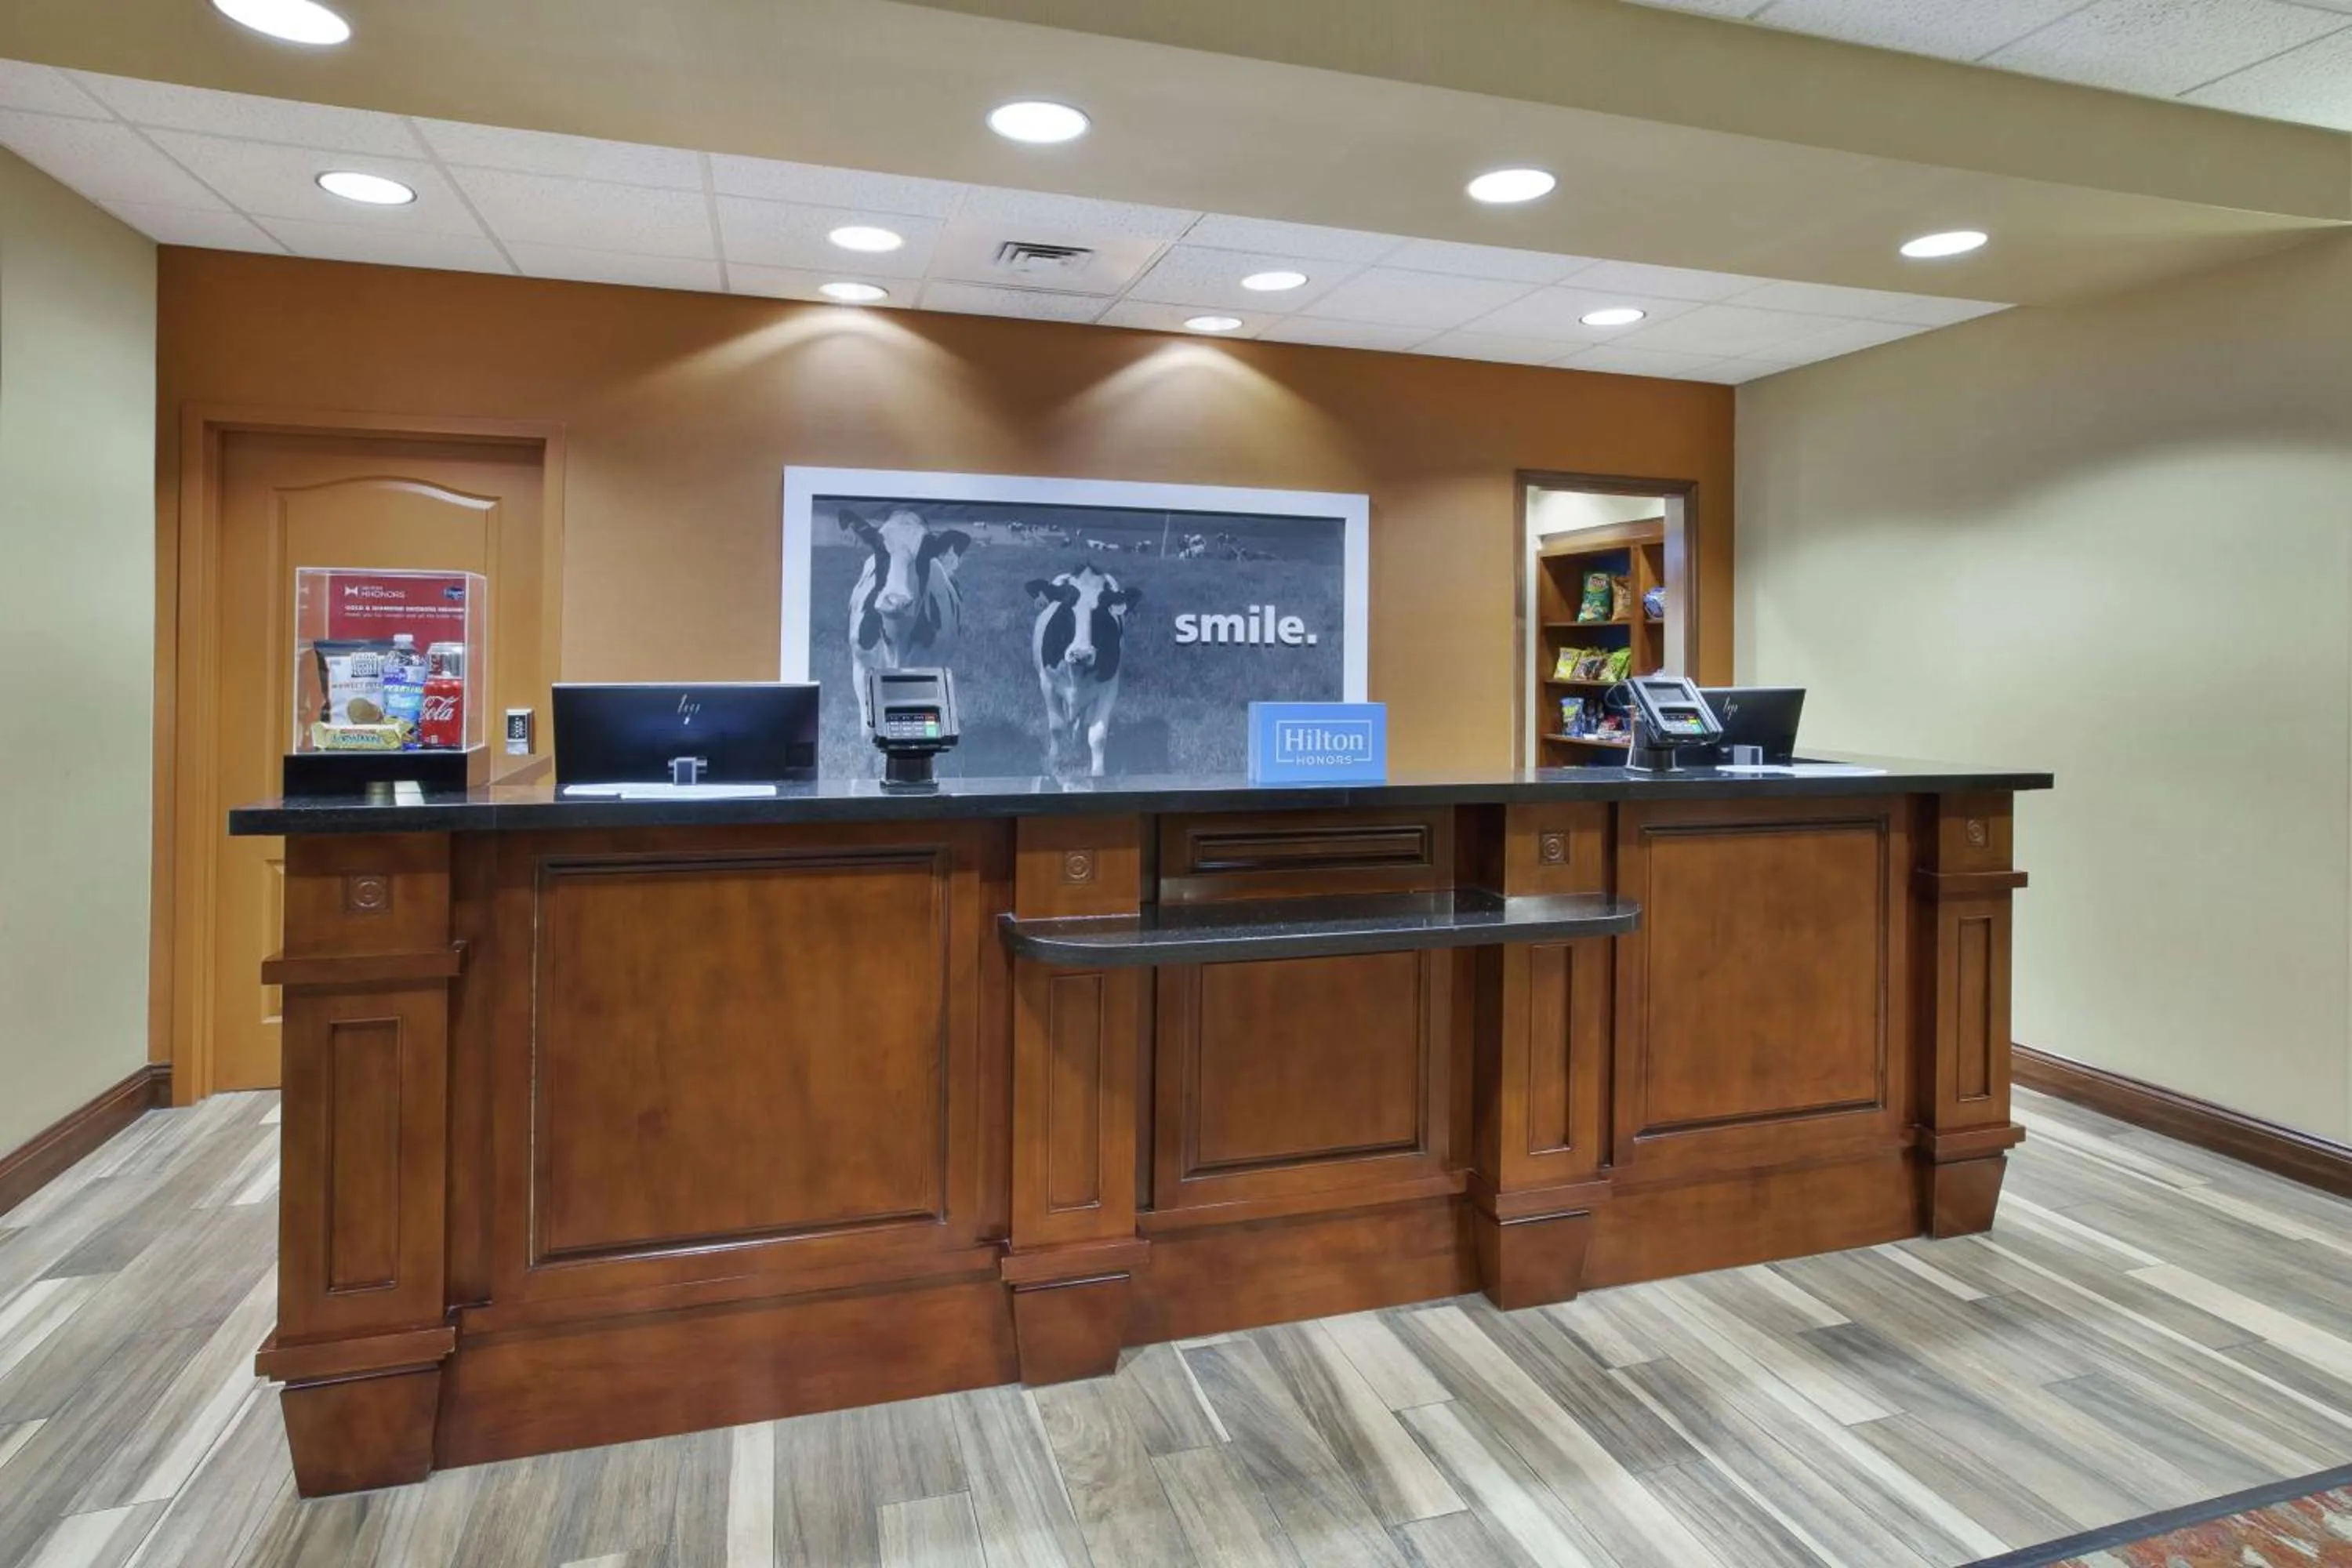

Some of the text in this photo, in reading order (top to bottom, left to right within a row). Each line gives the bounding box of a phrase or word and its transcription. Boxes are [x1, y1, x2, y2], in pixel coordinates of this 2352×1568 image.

[1174, 604, 1317, 644] smile.
[677, 693, 701, 725] hp
[1285, 728, 1364, 752] Hilton
[1295, 754, 1353, 766] HONORS
